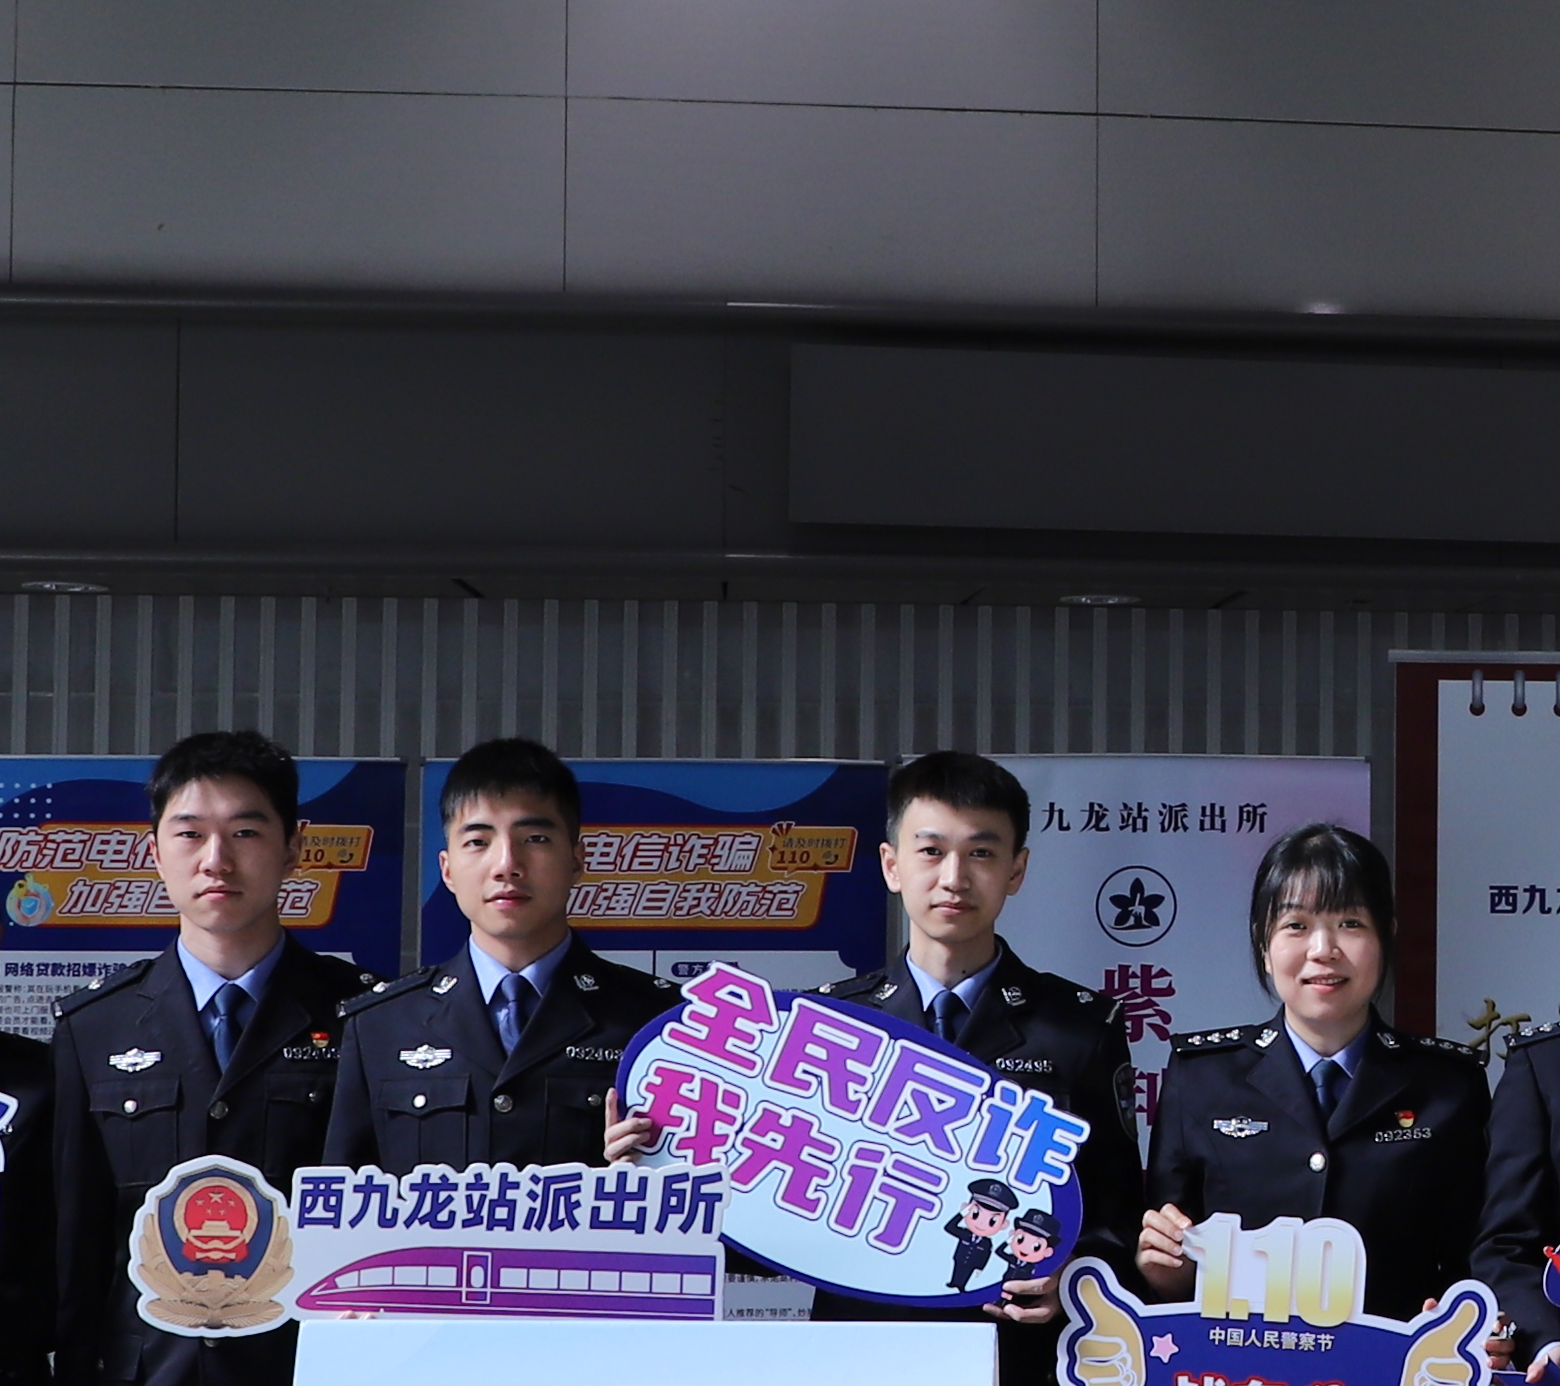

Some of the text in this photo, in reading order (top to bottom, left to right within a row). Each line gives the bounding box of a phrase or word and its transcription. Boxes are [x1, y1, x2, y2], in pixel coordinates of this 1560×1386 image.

[1026, 802, 1268, 834] 九龙站派出所
[301, 848, 325, 863] 10
[580, 832, 762, 873] 电信诈骗
[777, 849, 810, 864] 110
[664, 968, 1085, 1188] 全民反诈
[642, 1065, 943, 1253] 我先行
[297, 1171, 724, 1235] 西九龙站派出所
[1186, 1214, 1358, 1327] 1.10
[1208, 1327, 1336, 1353] 中国人民警察节
